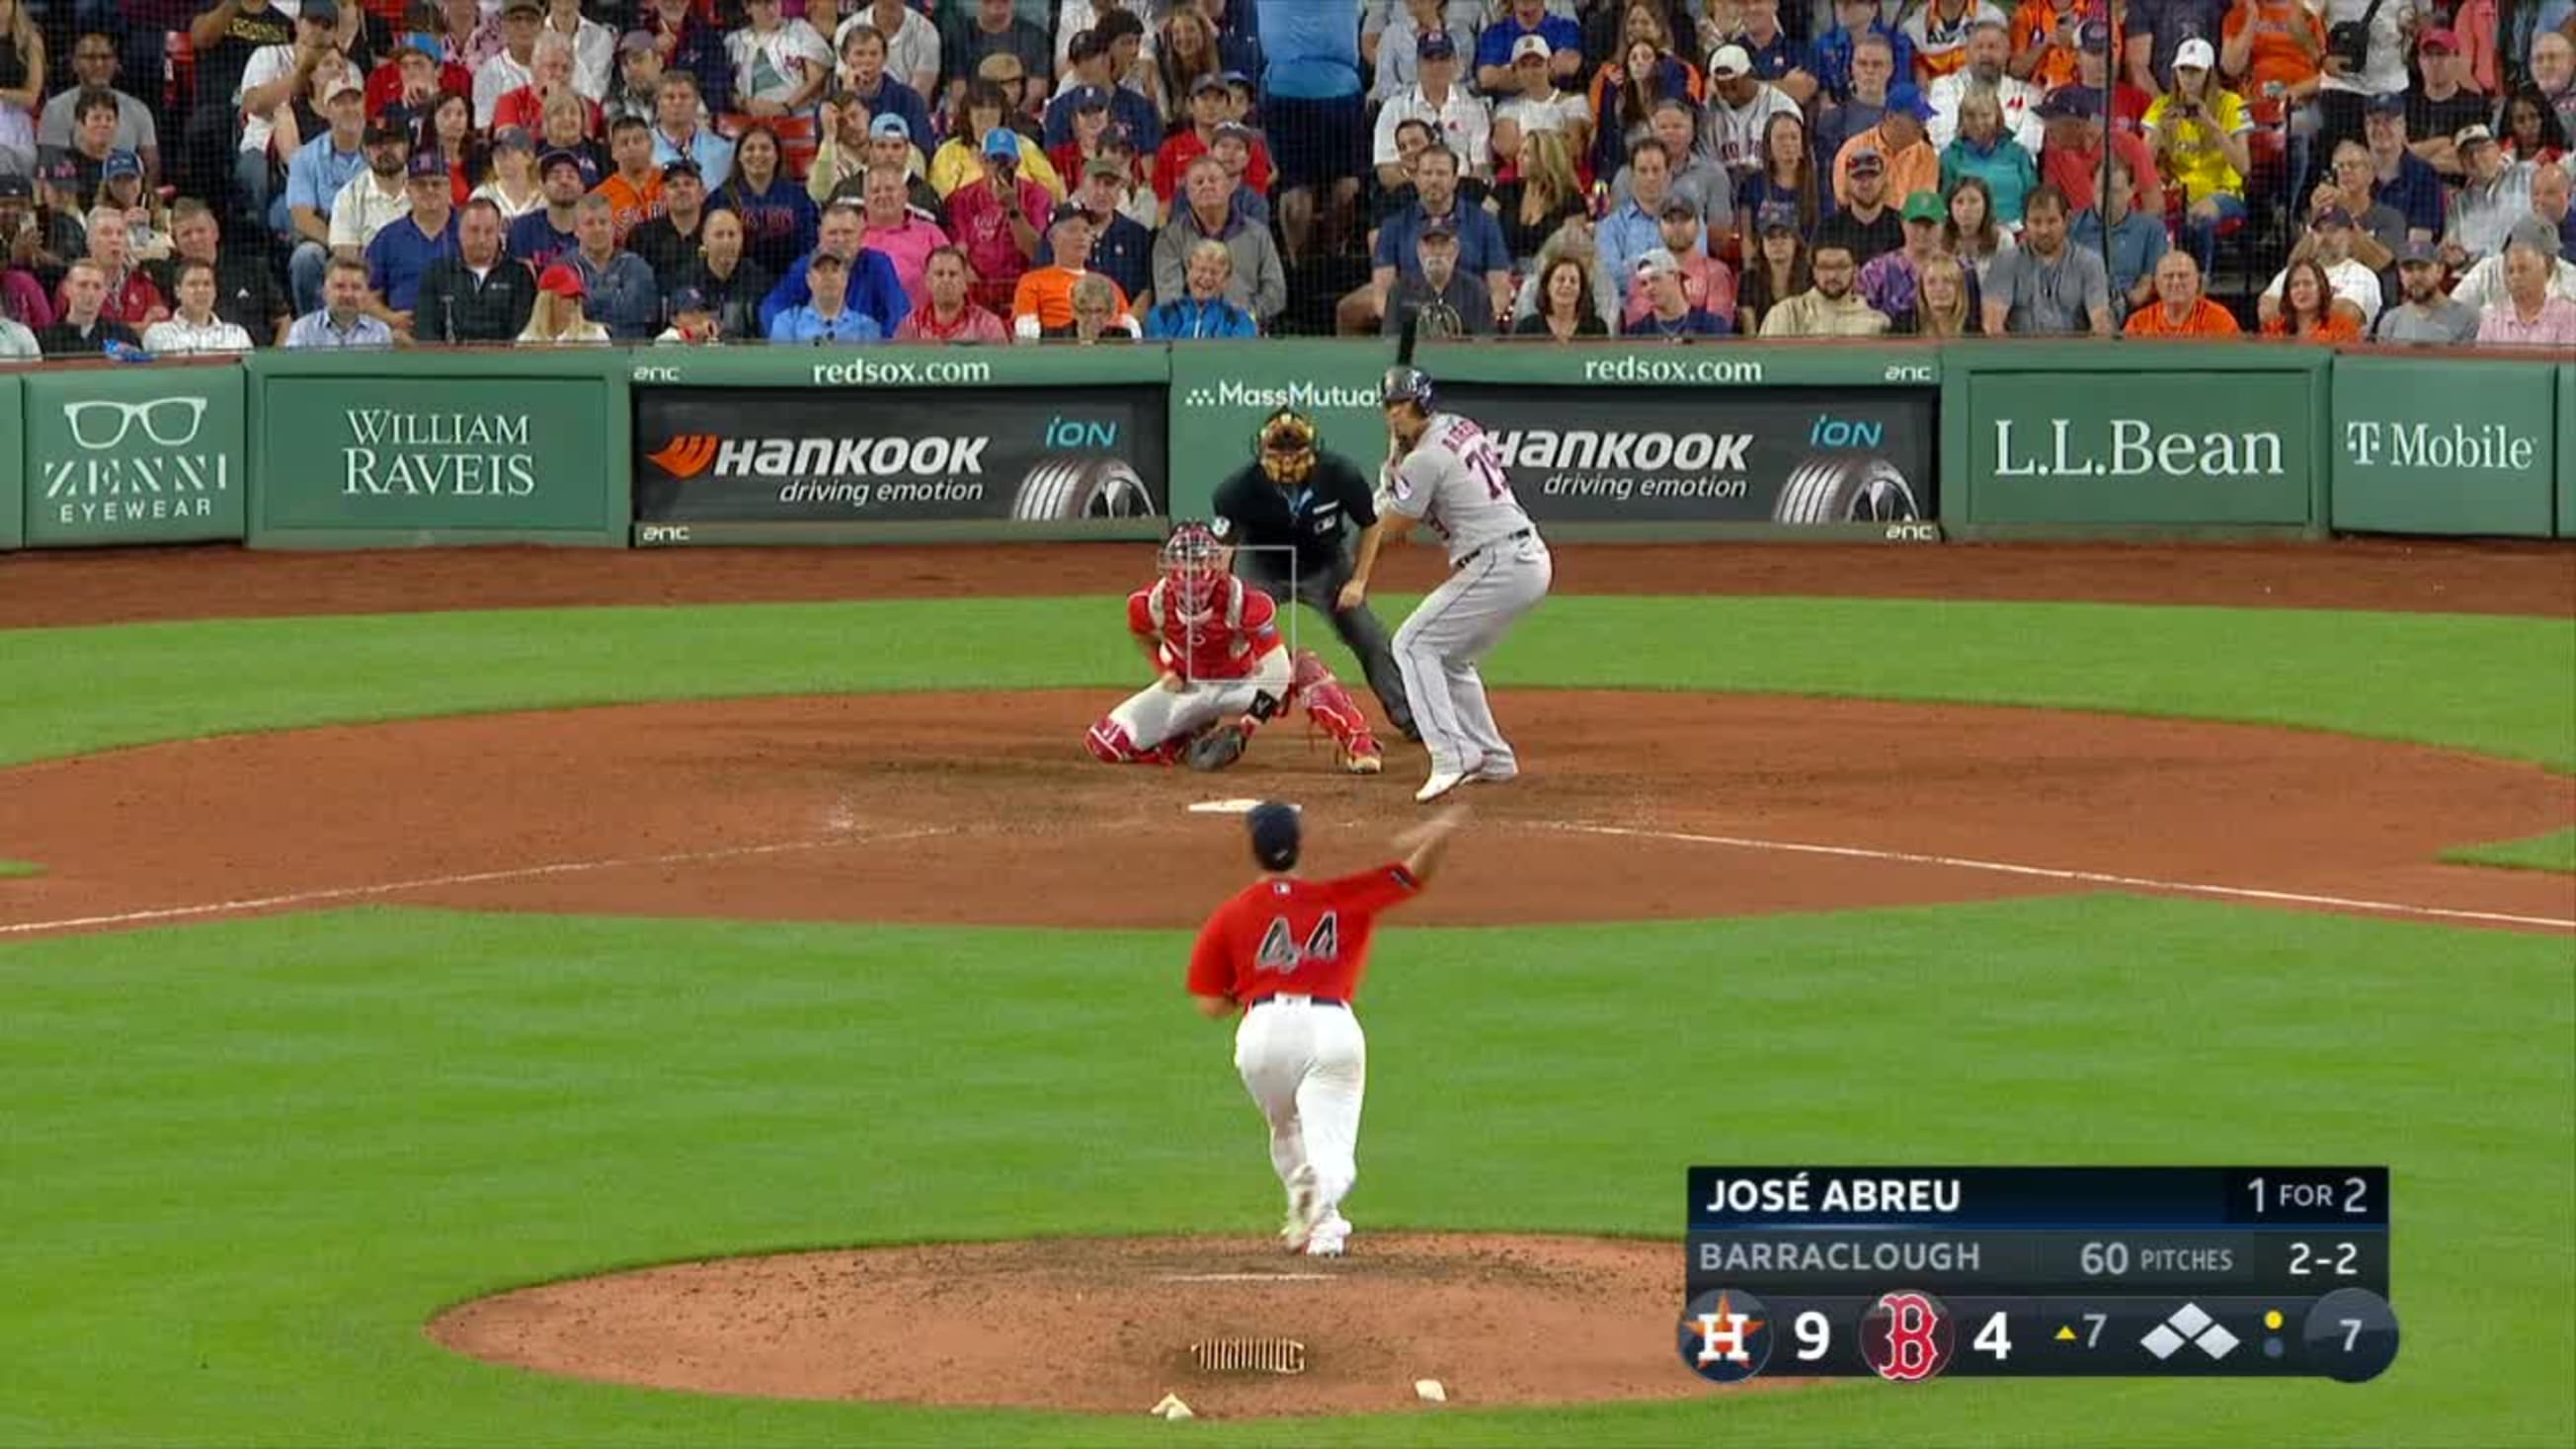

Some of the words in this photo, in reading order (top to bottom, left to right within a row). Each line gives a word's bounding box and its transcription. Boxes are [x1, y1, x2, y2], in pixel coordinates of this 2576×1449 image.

[813, 361, 990, 386] redsox.com
[1584, 358, 1762, 383] redsox.com
[347, 408, 530, 444] WILLIAM
[1994, 420, 2284, 476] L.L.Bean
[2390, 423, 2534, 469] Mobile
[44, 453, 227, 497] ZENNI
[342, 447, 535, 496] RAVEIS
[1543, 473, 1633, 500] driving
[1639, 474, 1747, 499] emotion
[59, 498, 211, 523] EYEWEAR
[779, 481, 867, 507] driving
[876, 481, 984, 502] emotion
[1253, 910, 1337, 975] 44
